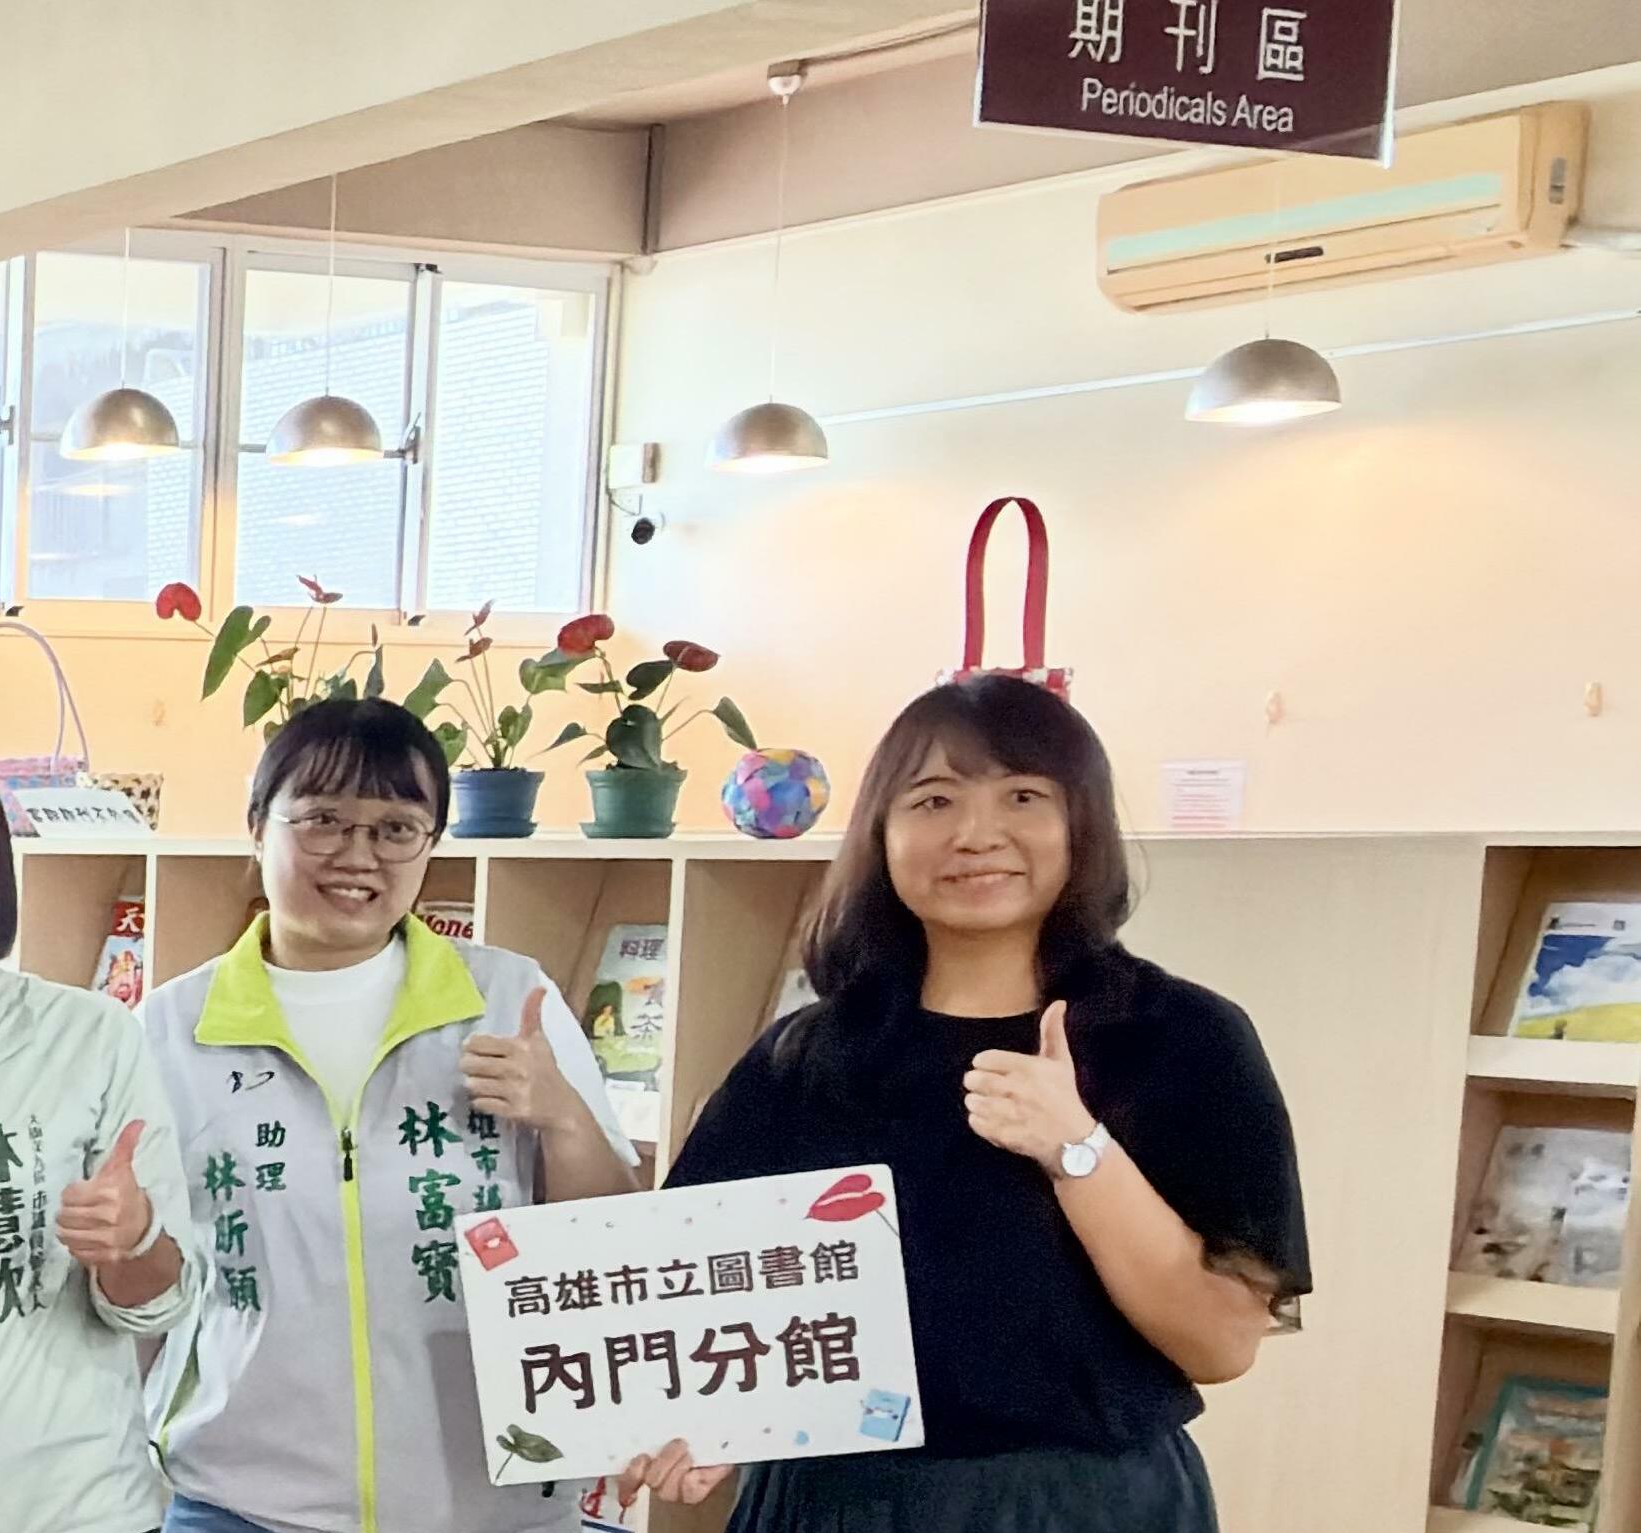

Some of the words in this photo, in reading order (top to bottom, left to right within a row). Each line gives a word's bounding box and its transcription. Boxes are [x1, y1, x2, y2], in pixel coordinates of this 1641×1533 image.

[1068, 0, 1308, 81] 期刊區
[1080, 77, 1227, 127] Periodicals
[1231, 95, 1295, 133] Area
[255, 1119, 287, 1192] 助理
[398, 1100, 463, 1304] 林富寶
[504, 1238, 860, 1319] 高雄市立圖書館
[520, 1311, 861, 1414] 內門分館
